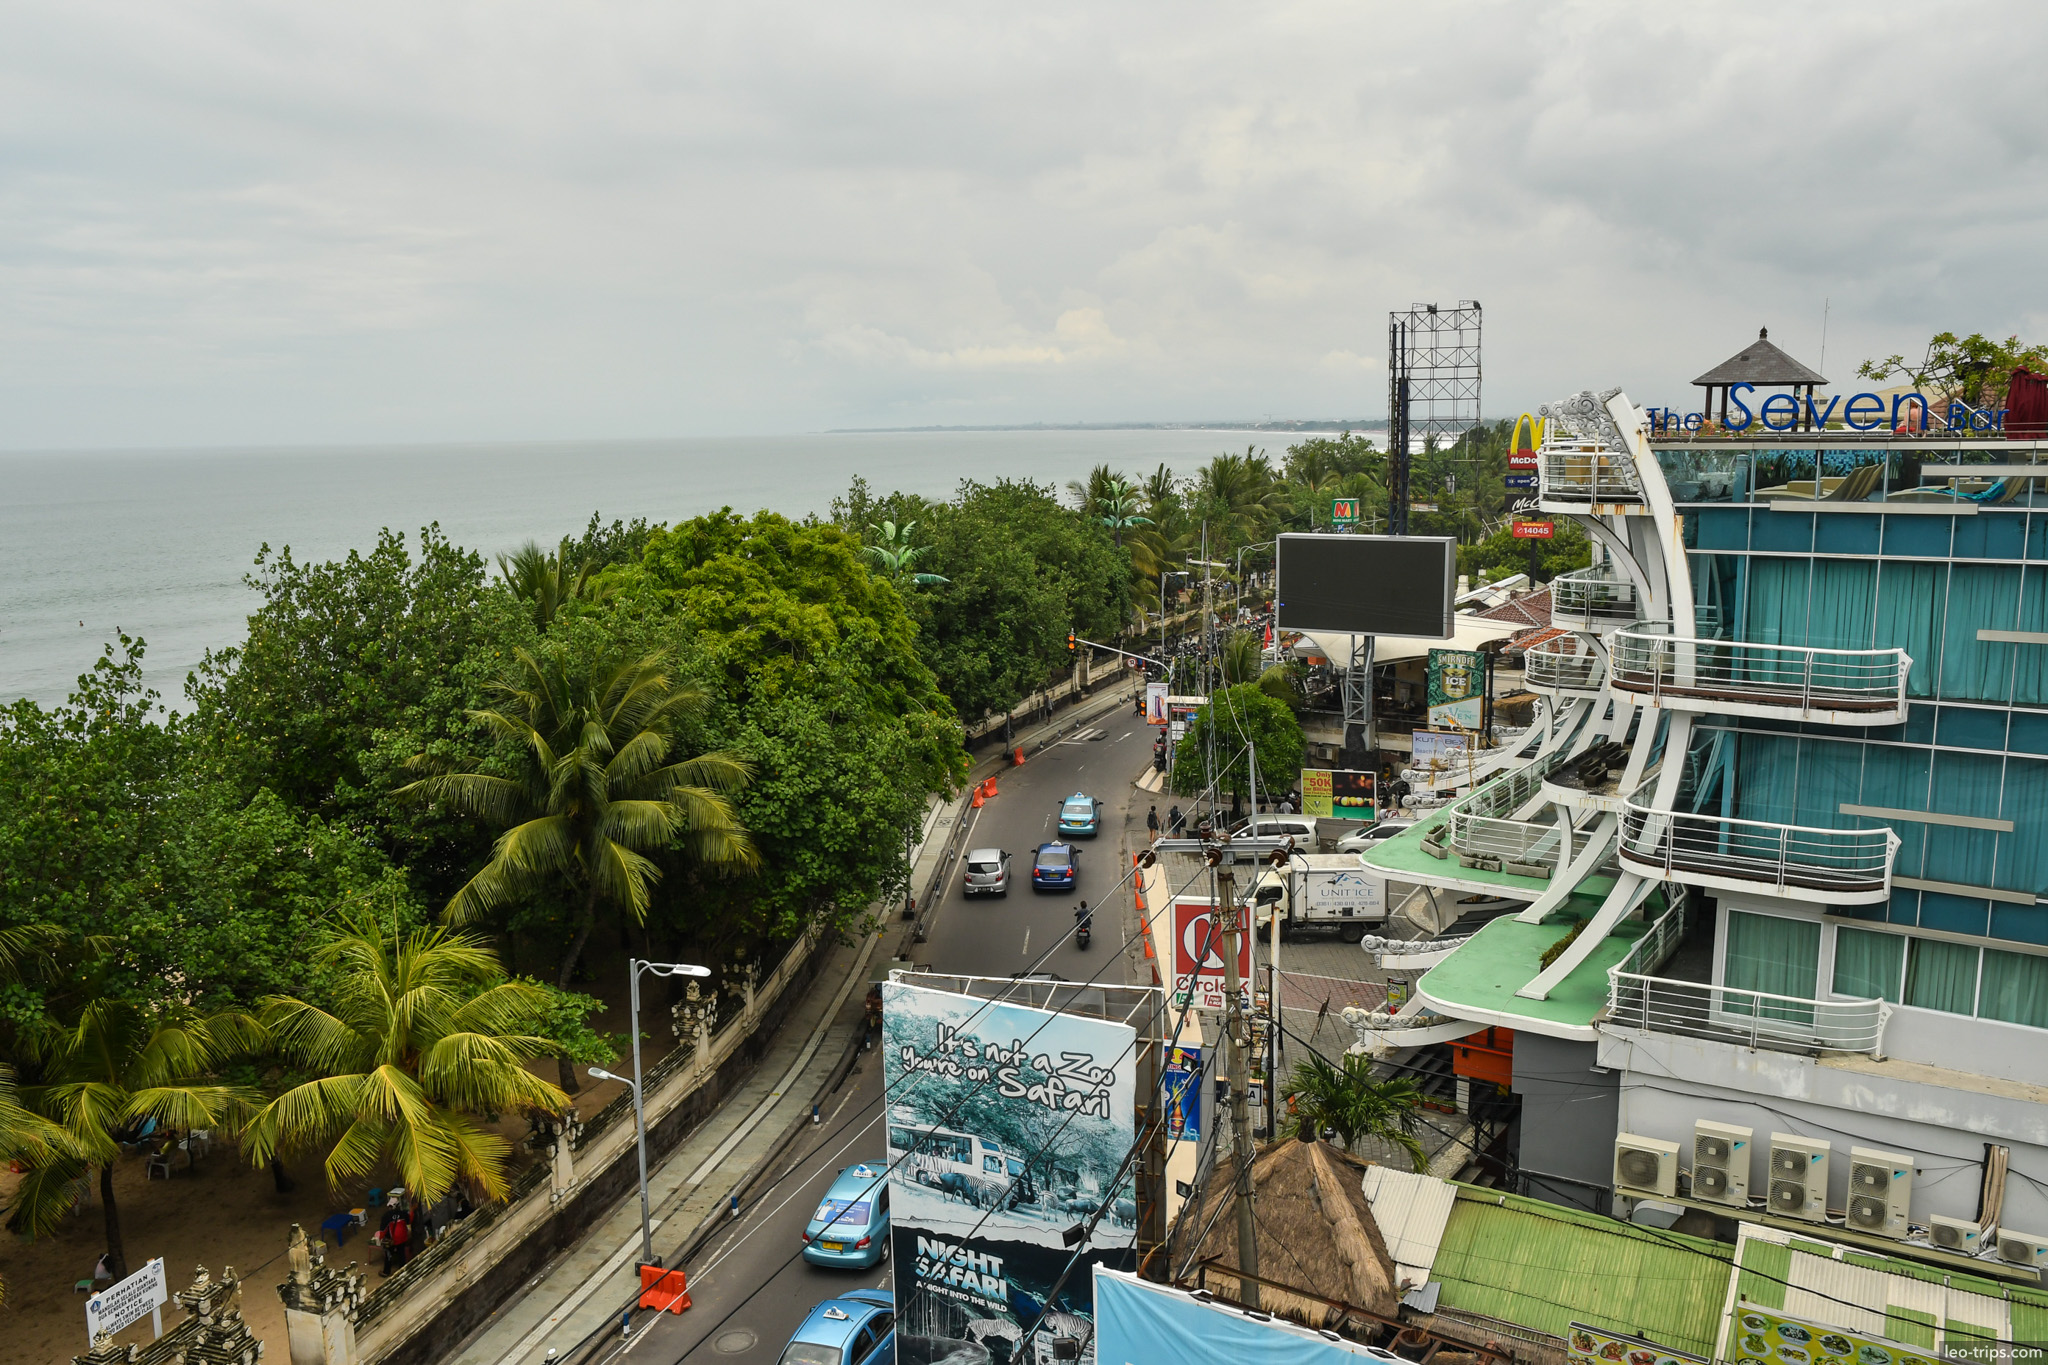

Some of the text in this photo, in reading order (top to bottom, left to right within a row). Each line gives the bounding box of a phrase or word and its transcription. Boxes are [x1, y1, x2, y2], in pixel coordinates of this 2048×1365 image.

[1647, 381, 2009, 432] The Seven Bar
[1437, 654, 1475, 667] SMIRNOFF
[1445, 676, 1466, 686] ICE
[1309, 778, 1332, 787] 50K
[1321, 889, 1351, 897] UNIT
[1176, 976, 1226, 993] Crcle
[937, 1022, 1116, 1086] It's not a Zoo
[965, 1066, 991, 1083] on
[997, 1067, 1111, 1119] Safari
[917, 1235, 1004, 1278] NIGHT
[106, 1274, 148, 1303] PERHATIAN
[915, 1256, 1008, 1301] SAFARI
[114, 1298, 143, 1318] NOTICE
[915, 1280, 1008, 1313] A NIGHT INTO THE WILD
